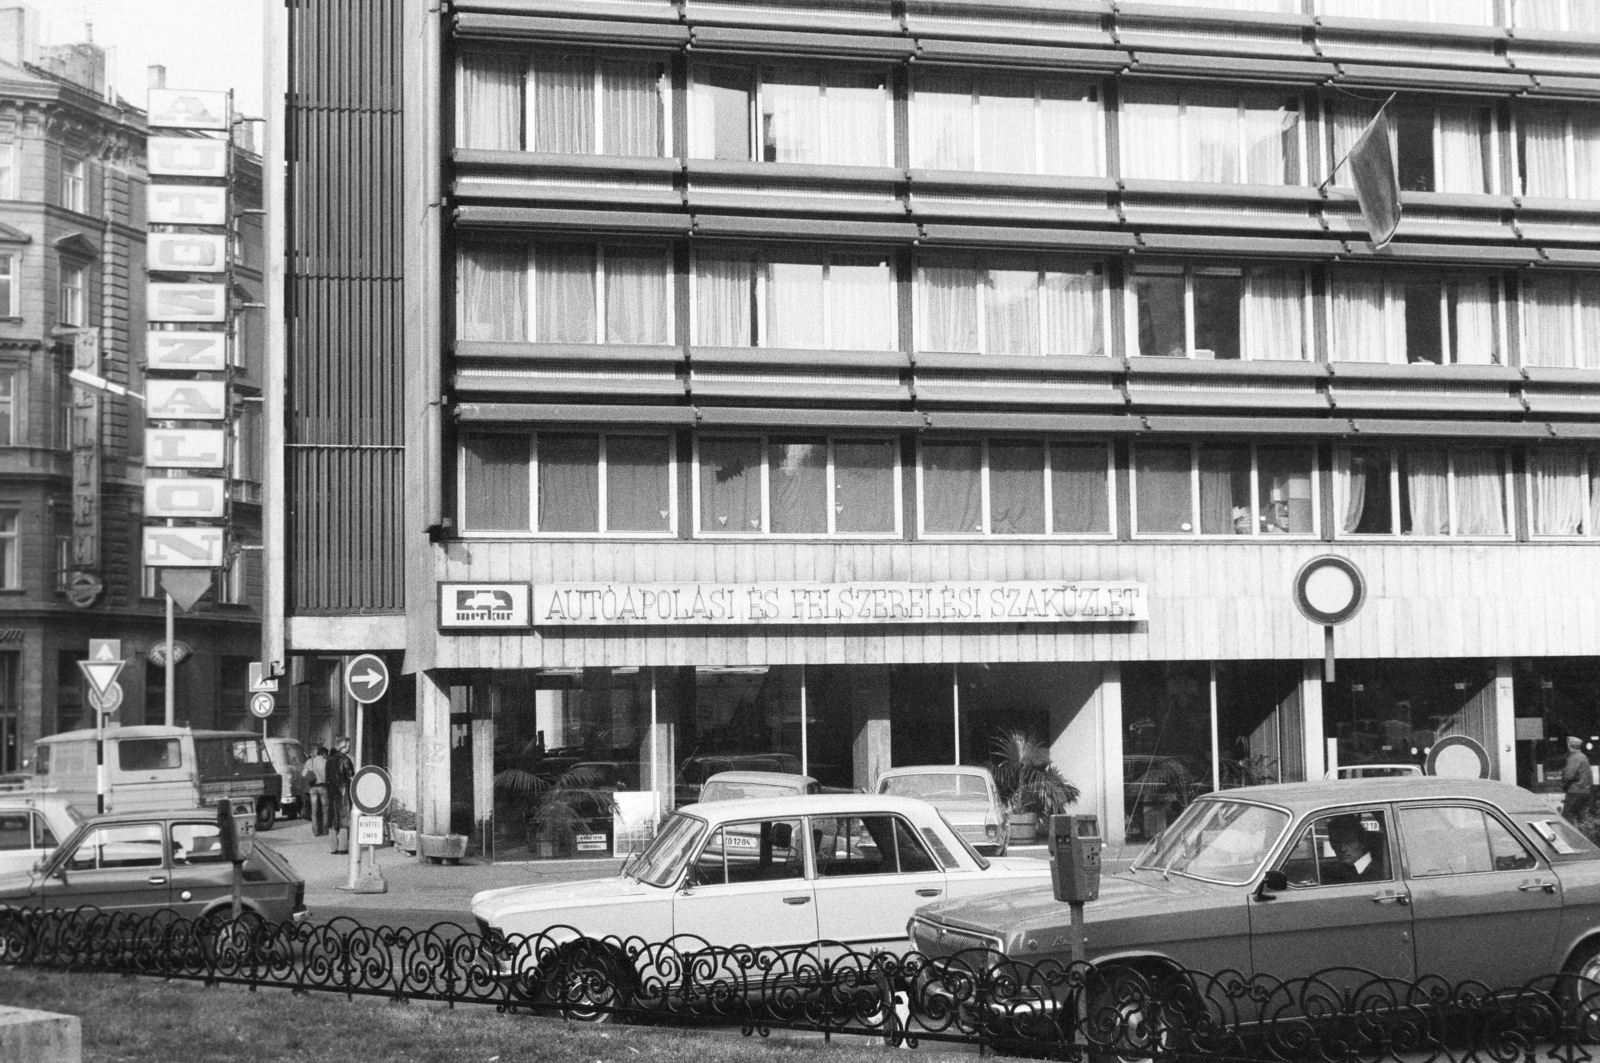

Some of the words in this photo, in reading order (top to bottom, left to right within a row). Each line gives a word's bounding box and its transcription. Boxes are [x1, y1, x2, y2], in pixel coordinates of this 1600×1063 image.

[544, 584, 734, 621] AUTÓÁPOLÁSI
[746, 586, 780, 620] ÉS
[791, 585, 981, 620] FELSZERELÉSI
[990, 585, 1140, 618] SZAKÜZLET
[456, 609, 513, 621] merkur
